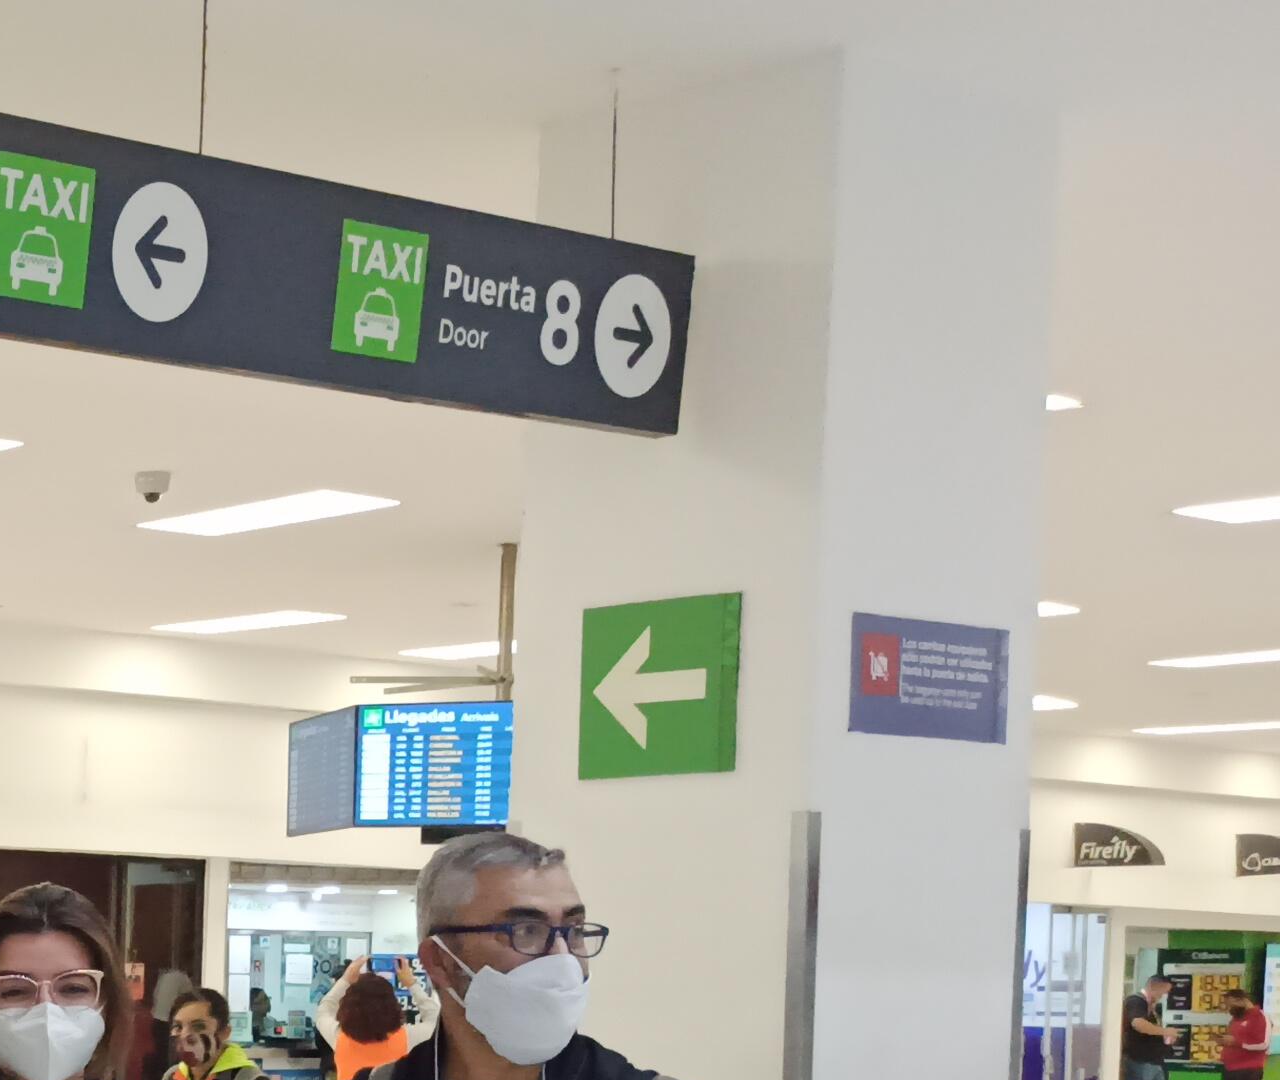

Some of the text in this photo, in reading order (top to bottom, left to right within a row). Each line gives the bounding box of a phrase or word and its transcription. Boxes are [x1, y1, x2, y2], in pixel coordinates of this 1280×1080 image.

[0, 166, 90, 224] TAXI
[347, 233, 424, 285] TAXI
[438, 317, 490, 350] Door
[443, 263, 582, 366] Puerta 8
[384, 708, 456, 726] Llegadas
[1079, 836, 1138, 863] Firefly
